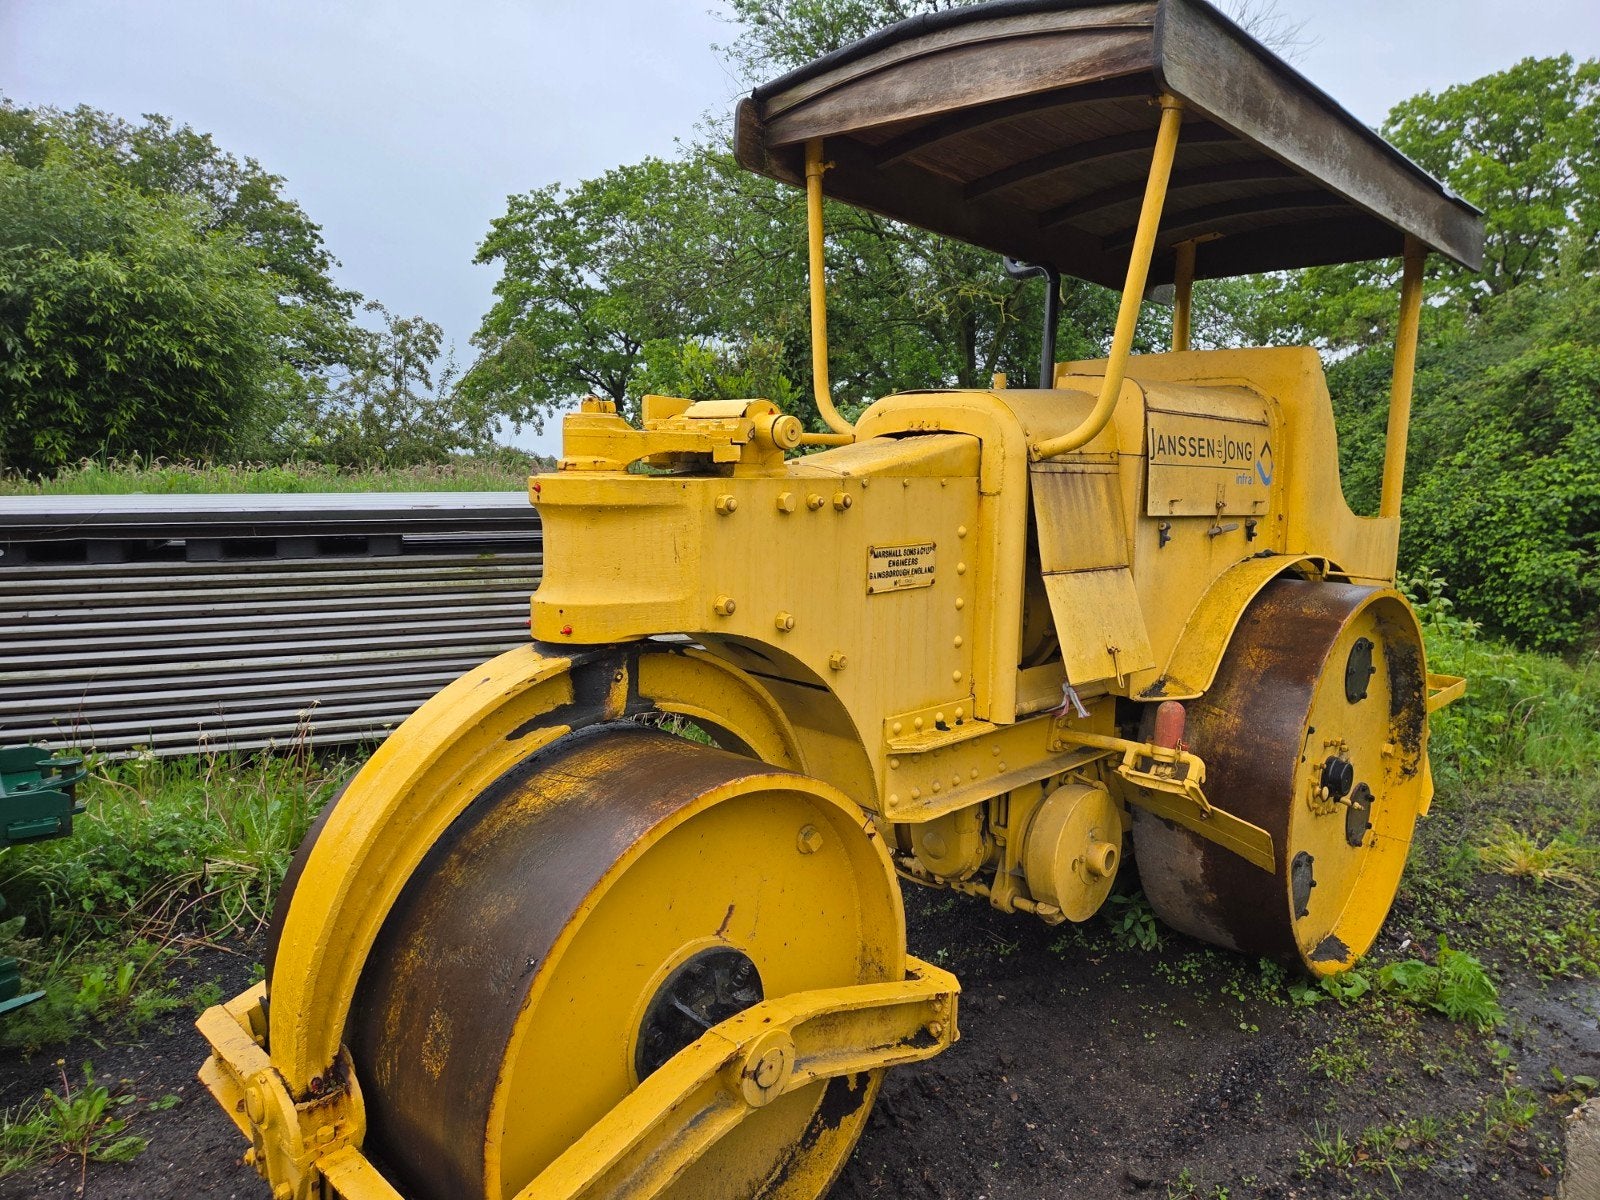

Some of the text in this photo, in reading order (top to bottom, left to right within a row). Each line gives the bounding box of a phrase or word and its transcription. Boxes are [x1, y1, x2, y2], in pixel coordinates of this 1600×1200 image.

[1150, 428, 1252, 464] JANSSEN de JONG
[1236, 473, 1253, 485] infra
[873, 549, 902, 559] MARSHALL
[903, 548, 917, 556] SONS
[888, 558, 918, 567] ENGINEERS
[911, 566, 935, 575] ENGLAND
